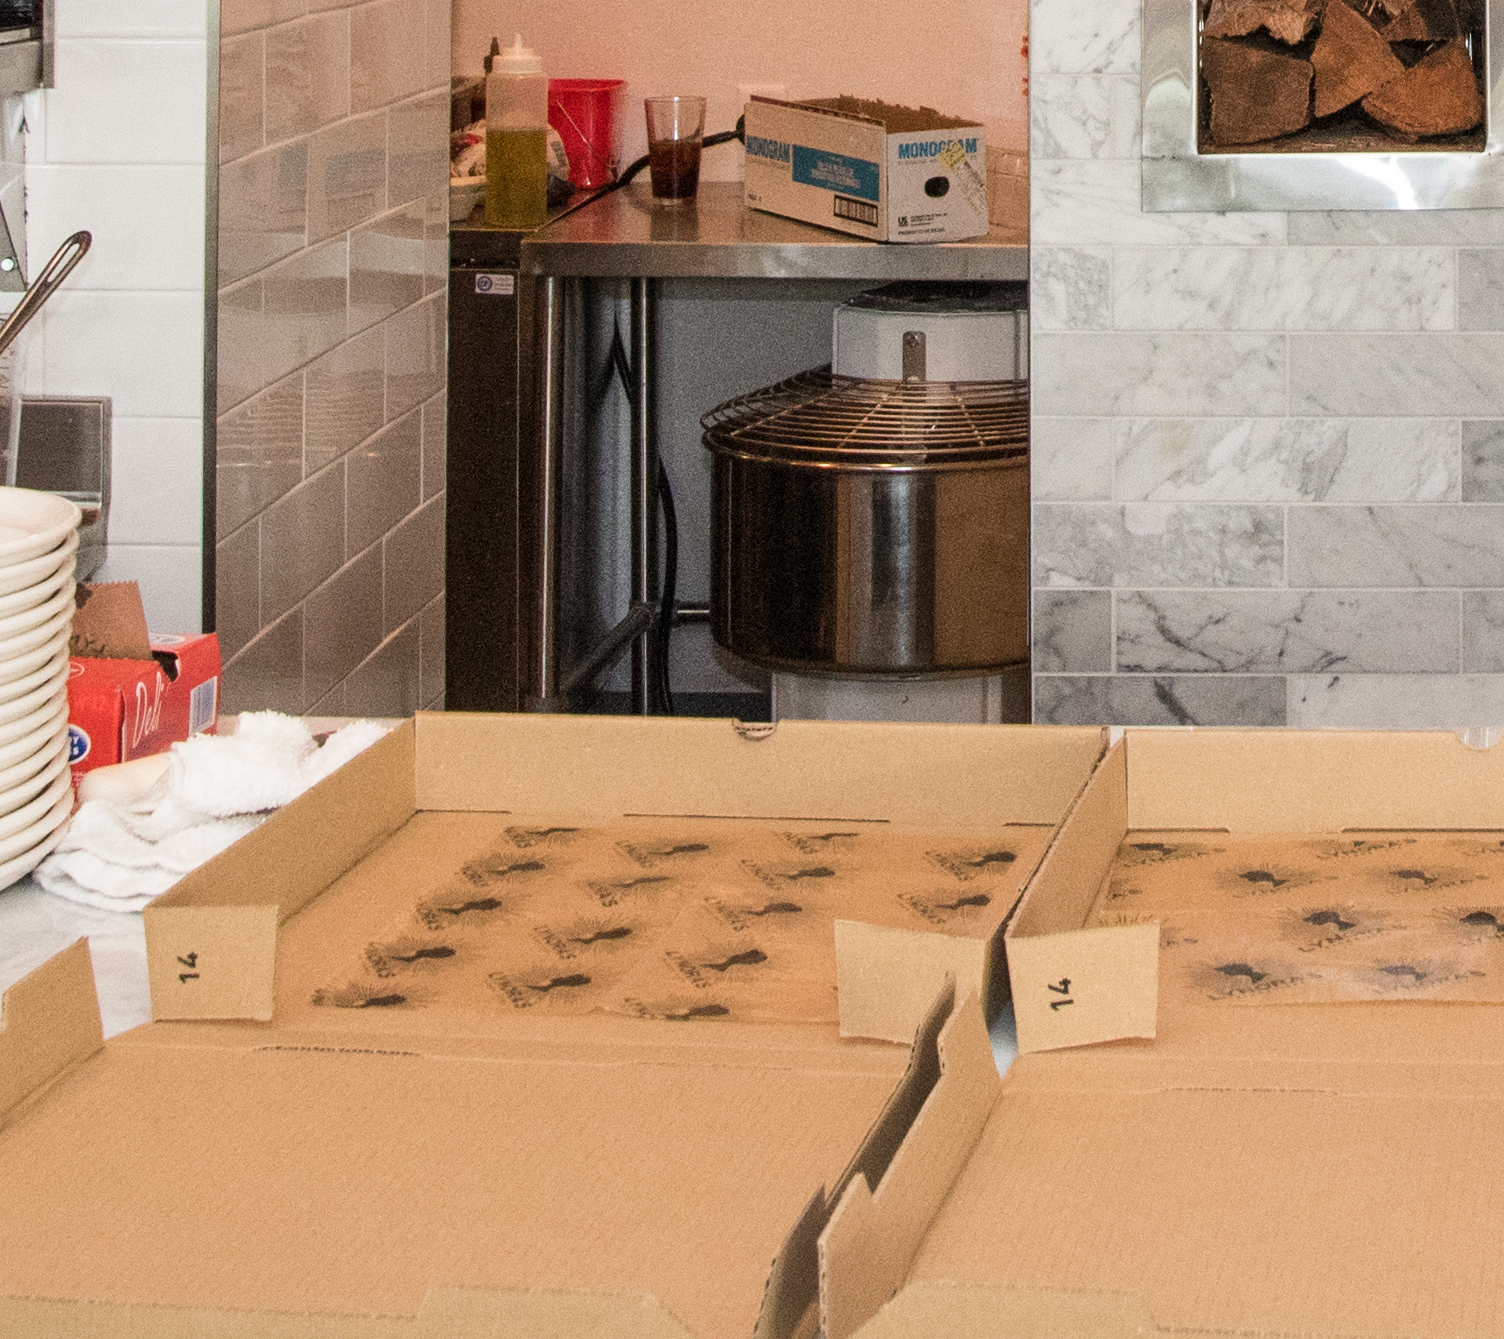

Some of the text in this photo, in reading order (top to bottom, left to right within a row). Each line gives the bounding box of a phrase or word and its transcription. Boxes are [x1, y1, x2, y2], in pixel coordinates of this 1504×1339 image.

[898, 138, 978, 159] MONOM
[132, 672, 165, 749] Deli
[177, 952, 200, 984] 14
[1047, 978, 1074, 1012] 14
